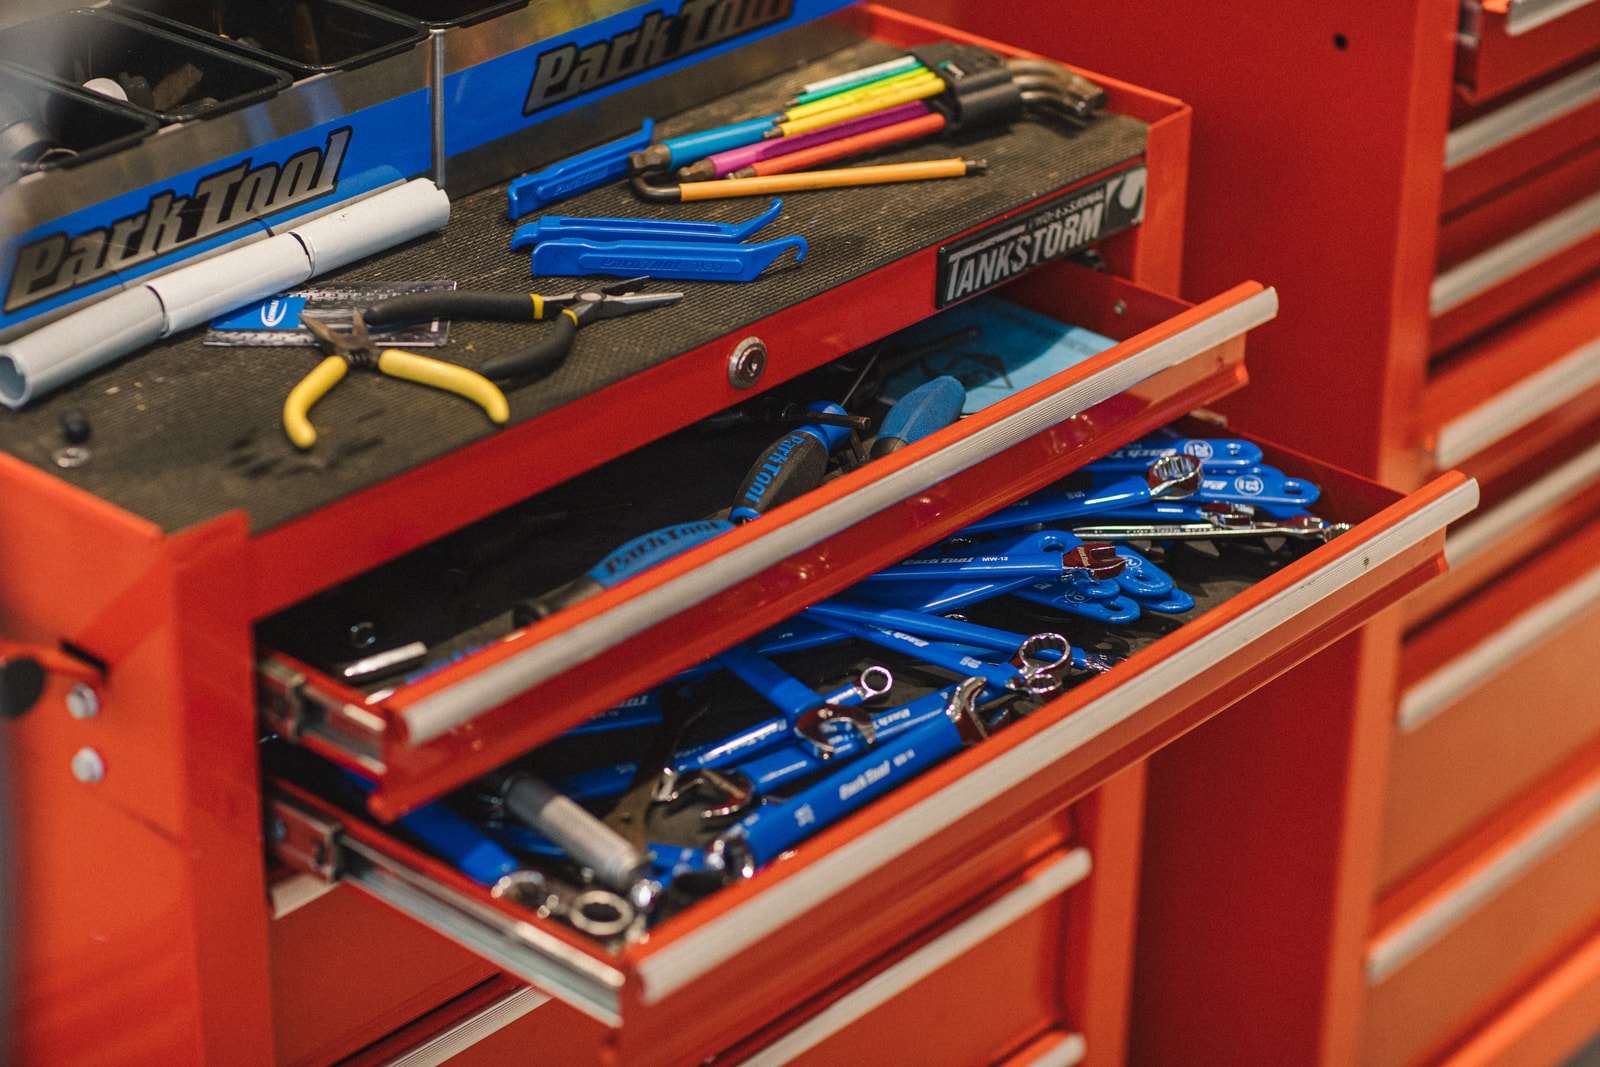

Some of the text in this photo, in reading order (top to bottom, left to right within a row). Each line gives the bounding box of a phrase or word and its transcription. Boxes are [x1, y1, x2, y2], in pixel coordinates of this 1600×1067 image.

[523, 9, 674, 117] Park
[4, 126, 353, 315] Park Tool
[946, 203, 1104, 302] TANKSTORM
